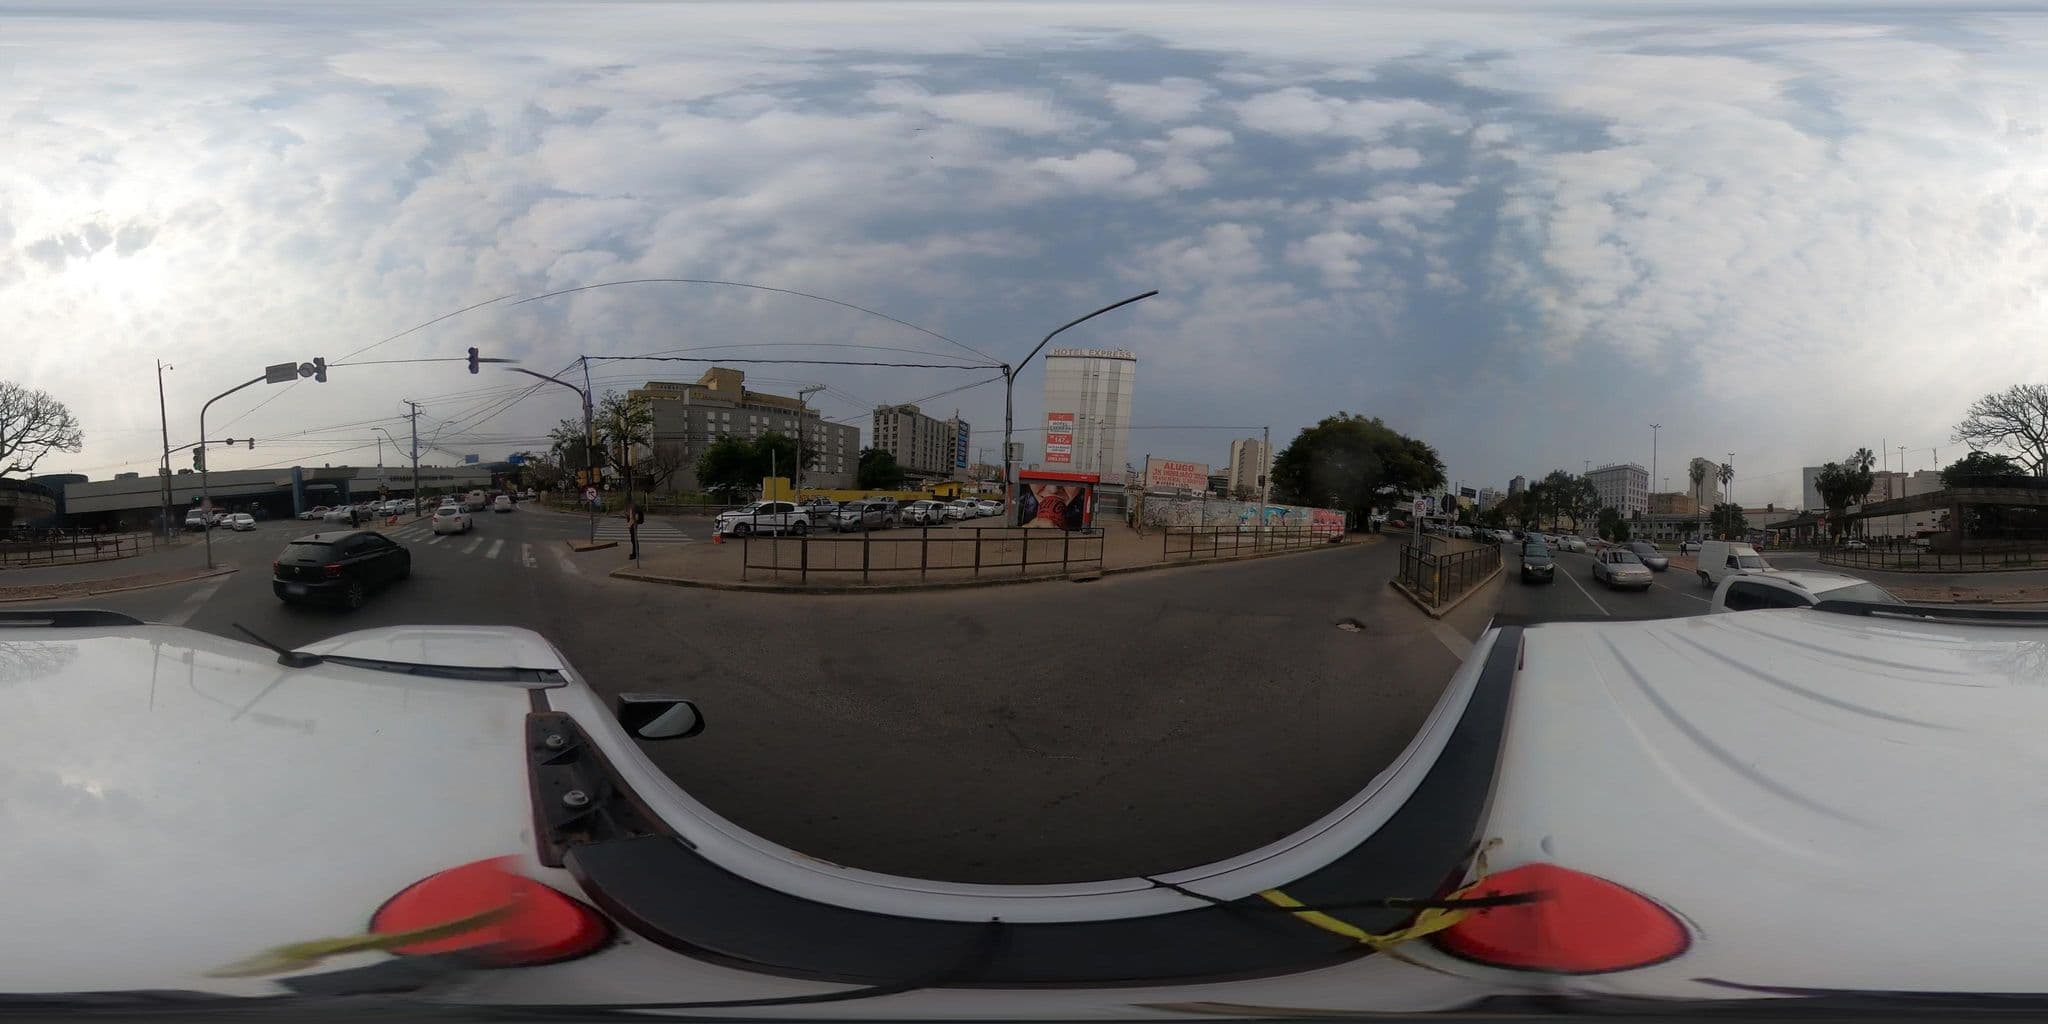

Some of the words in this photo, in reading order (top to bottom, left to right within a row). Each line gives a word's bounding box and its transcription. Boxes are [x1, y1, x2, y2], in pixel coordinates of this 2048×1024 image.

[1053, 348, 1085, 356] HOTEL
[1088, 349, 1132, 358] EXPRESS
[1164, 462, 1194, 472] ALUGO
